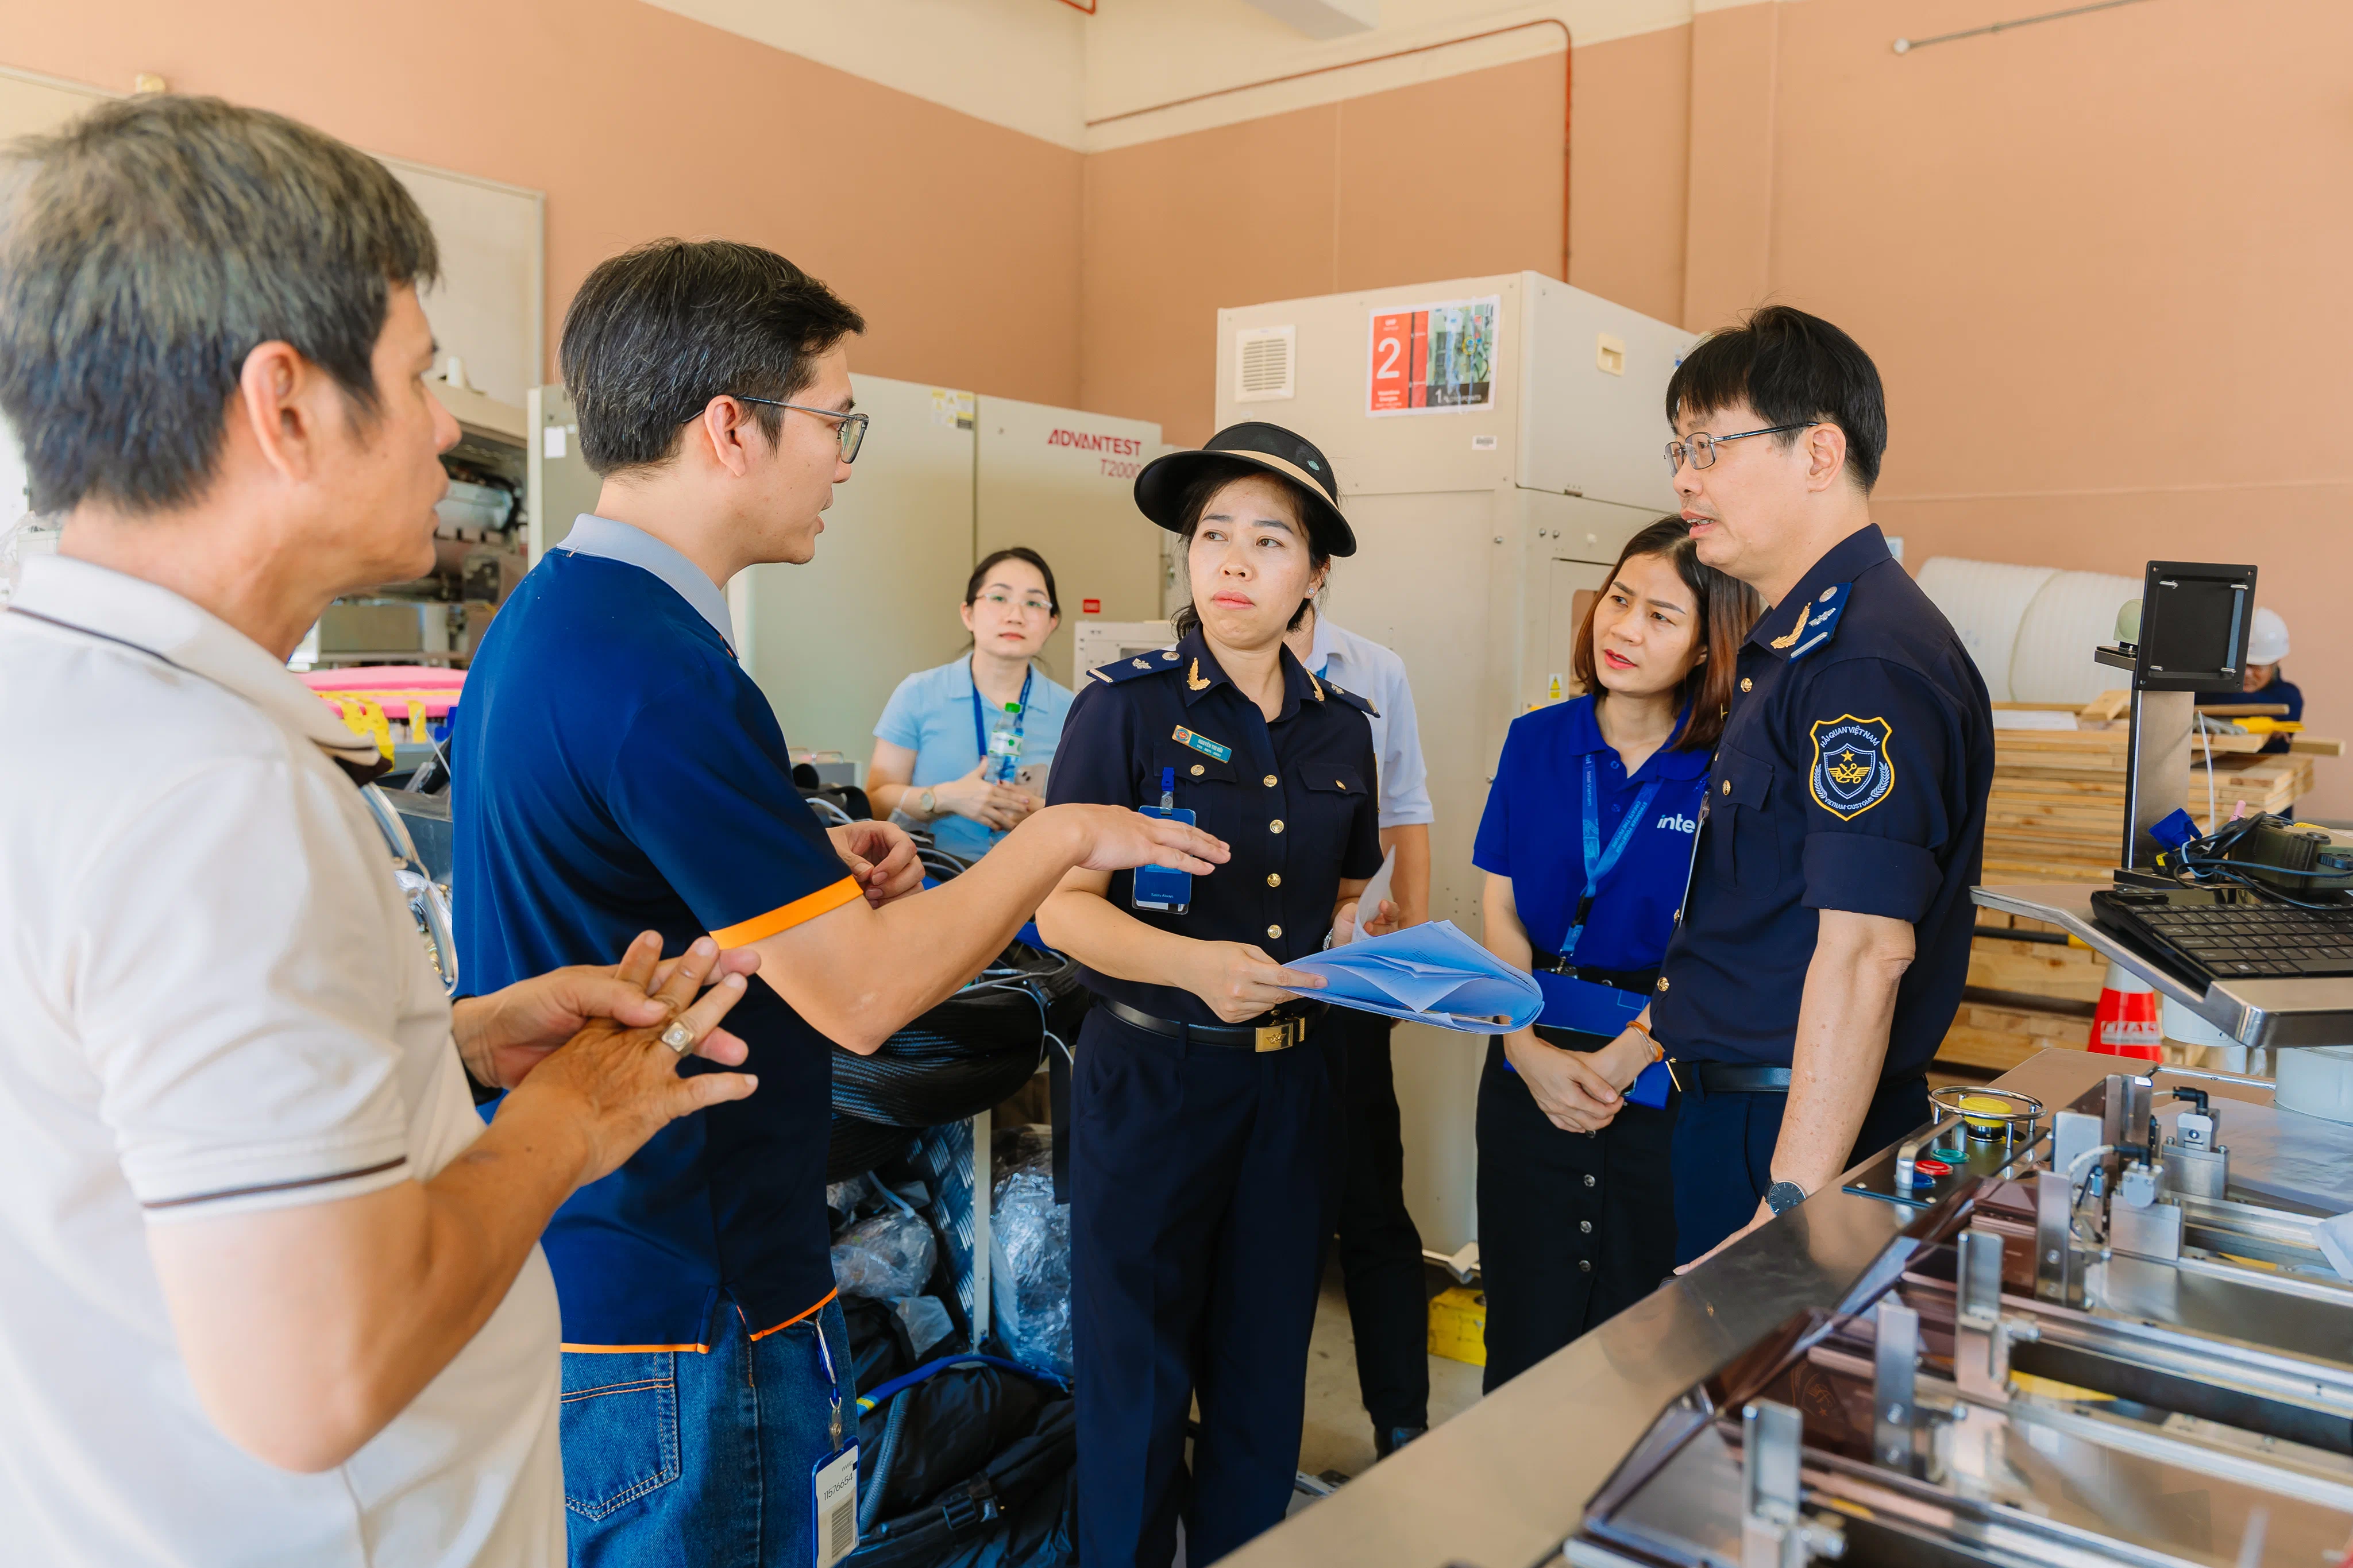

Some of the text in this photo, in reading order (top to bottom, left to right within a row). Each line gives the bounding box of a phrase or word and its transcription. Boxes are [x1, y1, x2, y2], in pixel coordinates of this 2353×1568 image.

[1376, 337, 1401, 379] 2
[1048, 428, 1142, 457] ADVANTEST
[1820, 725, 1881, 748] HẢI QUAN VIỆT NAM
[1627, 801, 1641, 818] CREATE
[1824, 797, 1874, 810] VIETNAM CUSTOMS
[1615, 801, 1648, 853] STRONGER TOGETHER
[1657, 814, 1696, 833] inte
[1611, 829, 1625, 849] FUTURE
[842, 1460, 853, 1472] WWID
[824, 1473, 853, 1501] 11576654
